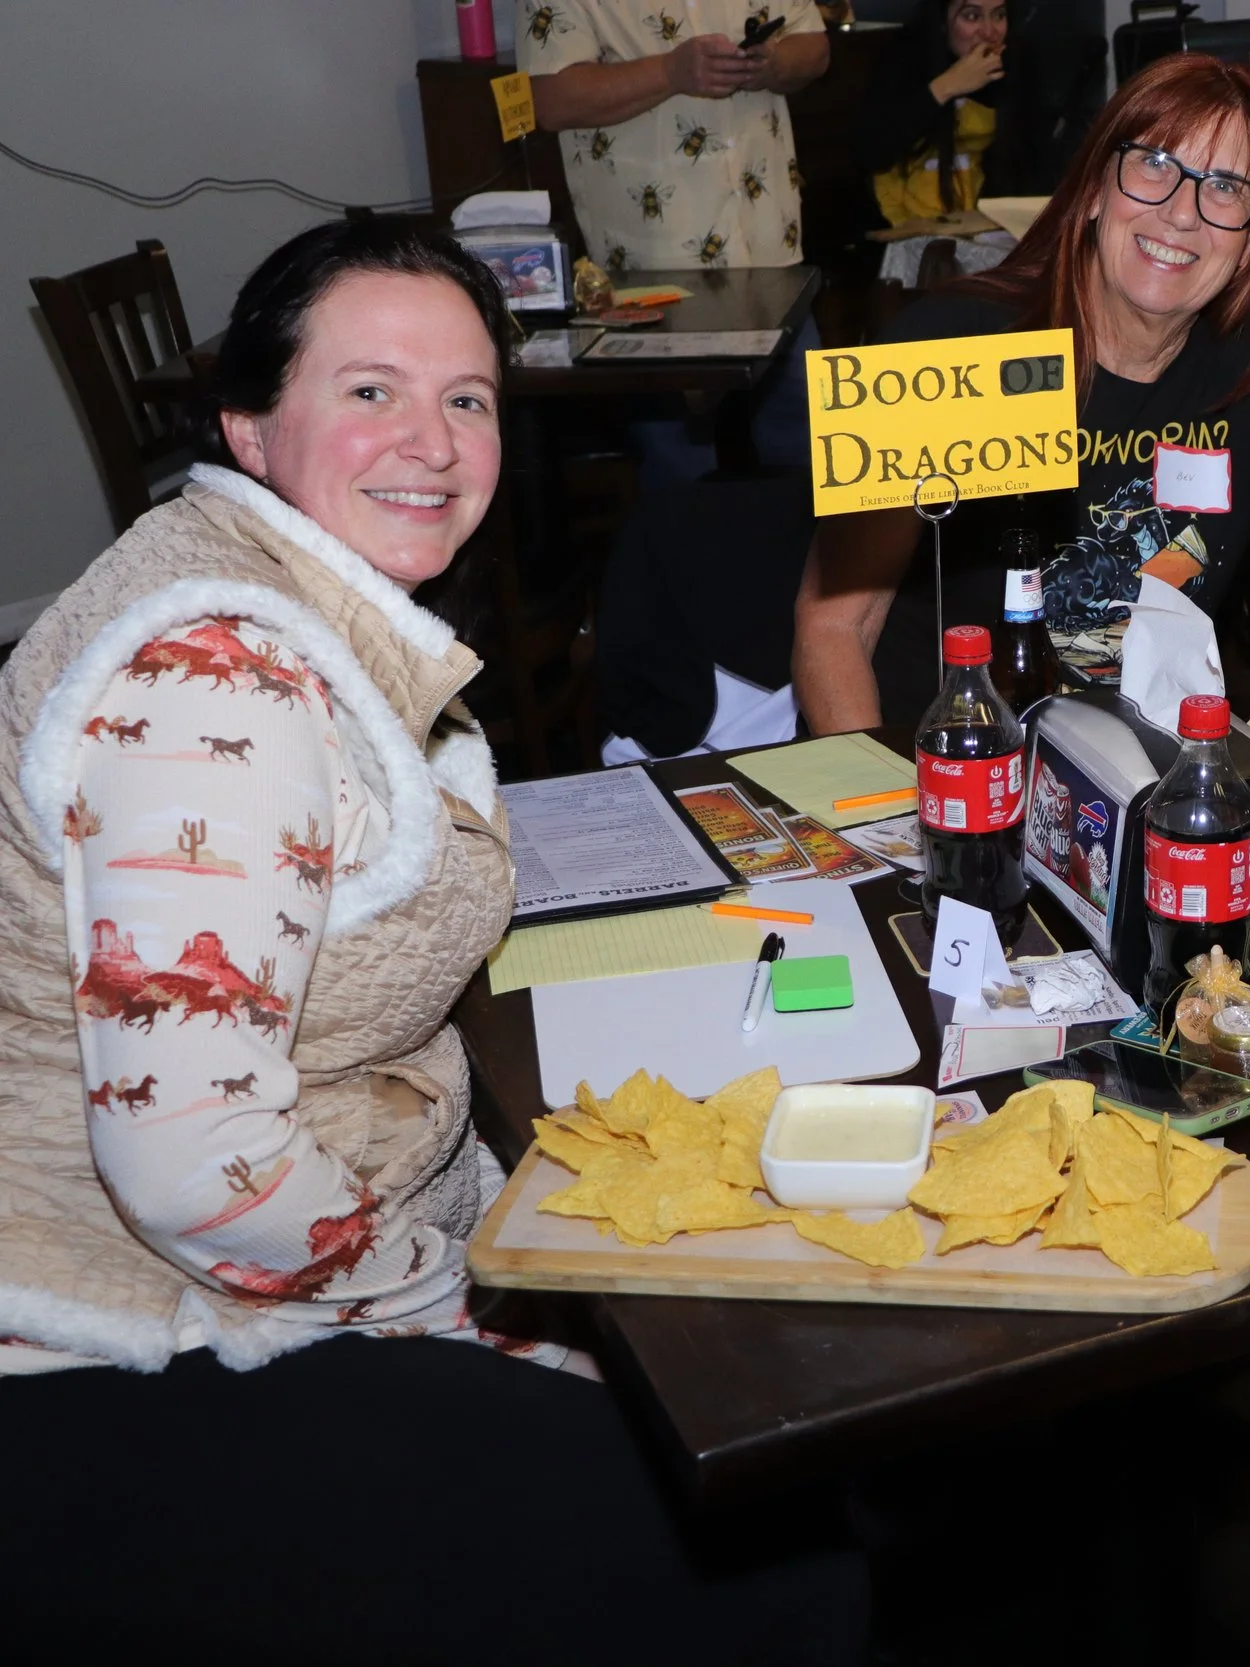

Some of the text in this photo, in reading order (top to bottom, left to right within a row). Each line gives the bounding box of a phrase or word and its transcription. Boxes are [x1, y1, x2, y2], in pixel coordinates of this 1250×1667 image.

[822, 355, 1064, 411] BOOK OF
[818, 429, 1074, 489] DRAGONS
[859, 493, 902, 507] FRIENDS
[976, 482, 1003, 495] BOOK
[1005, 480, 1030, 492] CLUB
[598, 880, 690, 896] BARRELS
[944, 939, 970, 967] 5
